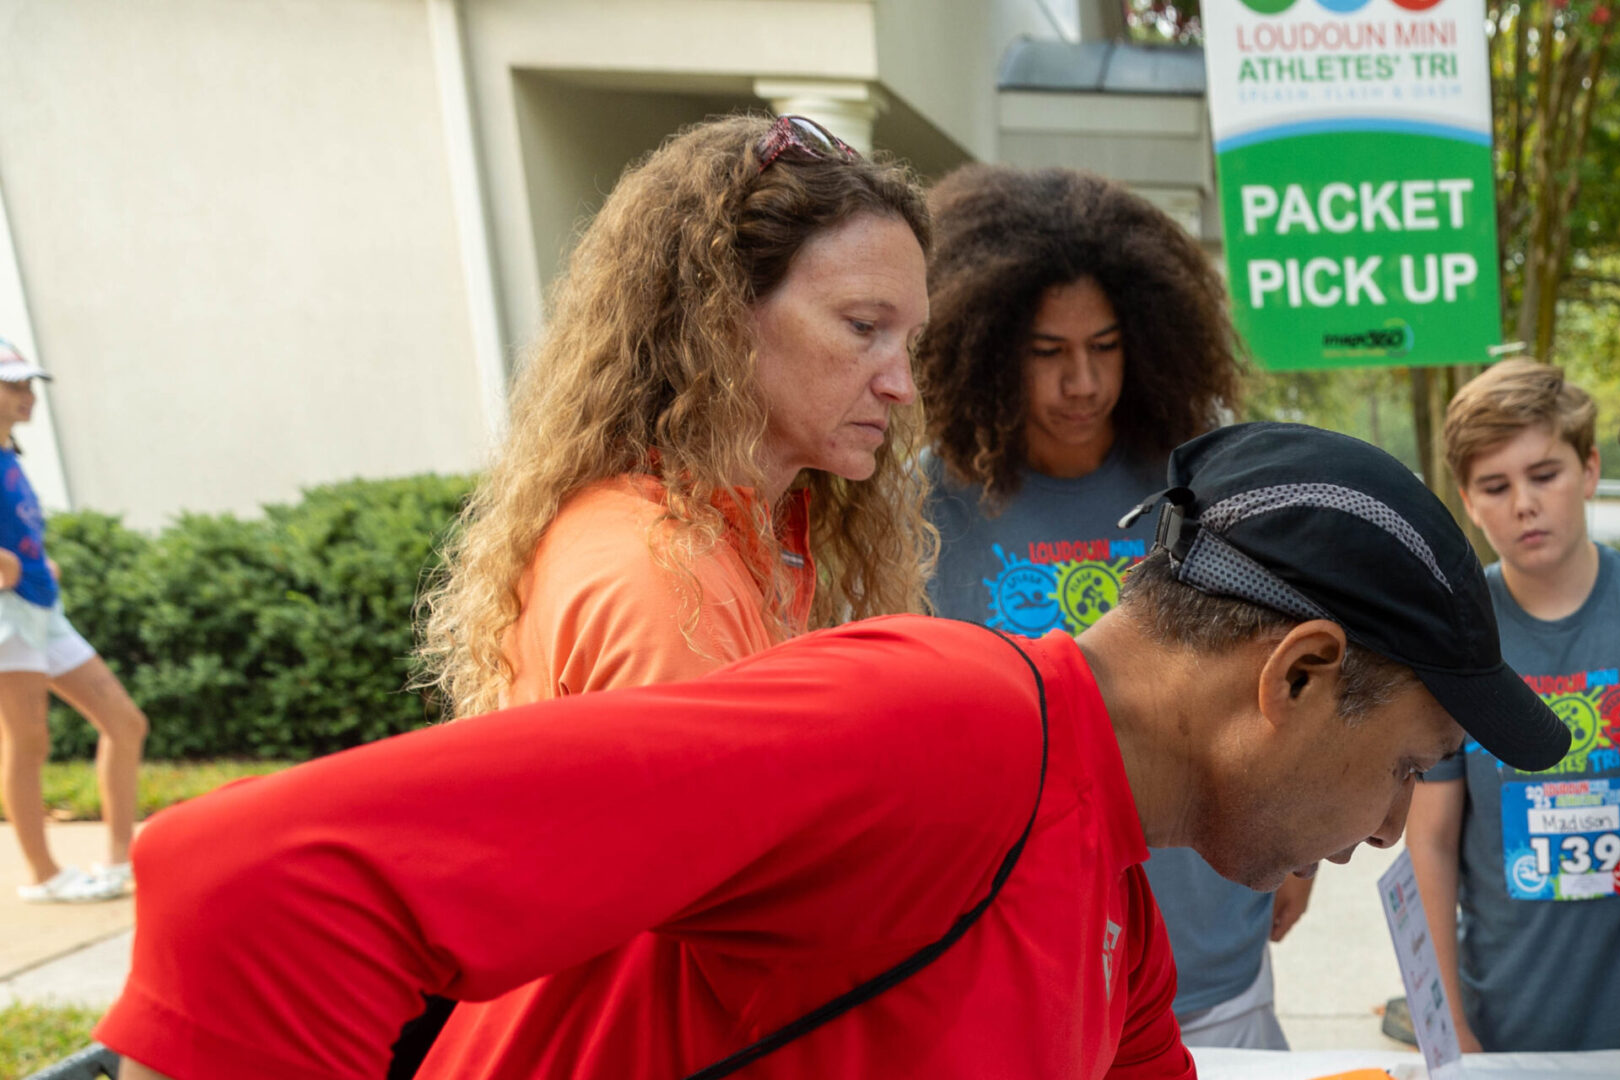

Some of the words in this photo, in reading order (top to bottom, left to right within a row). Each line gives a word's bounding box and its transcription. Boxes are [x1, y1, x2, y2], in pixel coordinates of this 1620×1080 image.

[1236, 21, 1385, 52] LOUDOUN
[1395, 20, 1457, 48] MINI
[1238, 53, 1402, 84] ATHLETES'
[1411, 53, 1459, 79] TRI
[1240, 178, 1474, 235] PACKET
[1246, 256, 1387, 309] PICK
[1400, 253, 1479, 304] UP
[1028, 538, 1110, 564] LOUDOUN
[1109, 536, 1146, 558] MINI
[1522, 671, 1587, 698] OUDOUN
[1542, 814, 1615, 833] Madison
